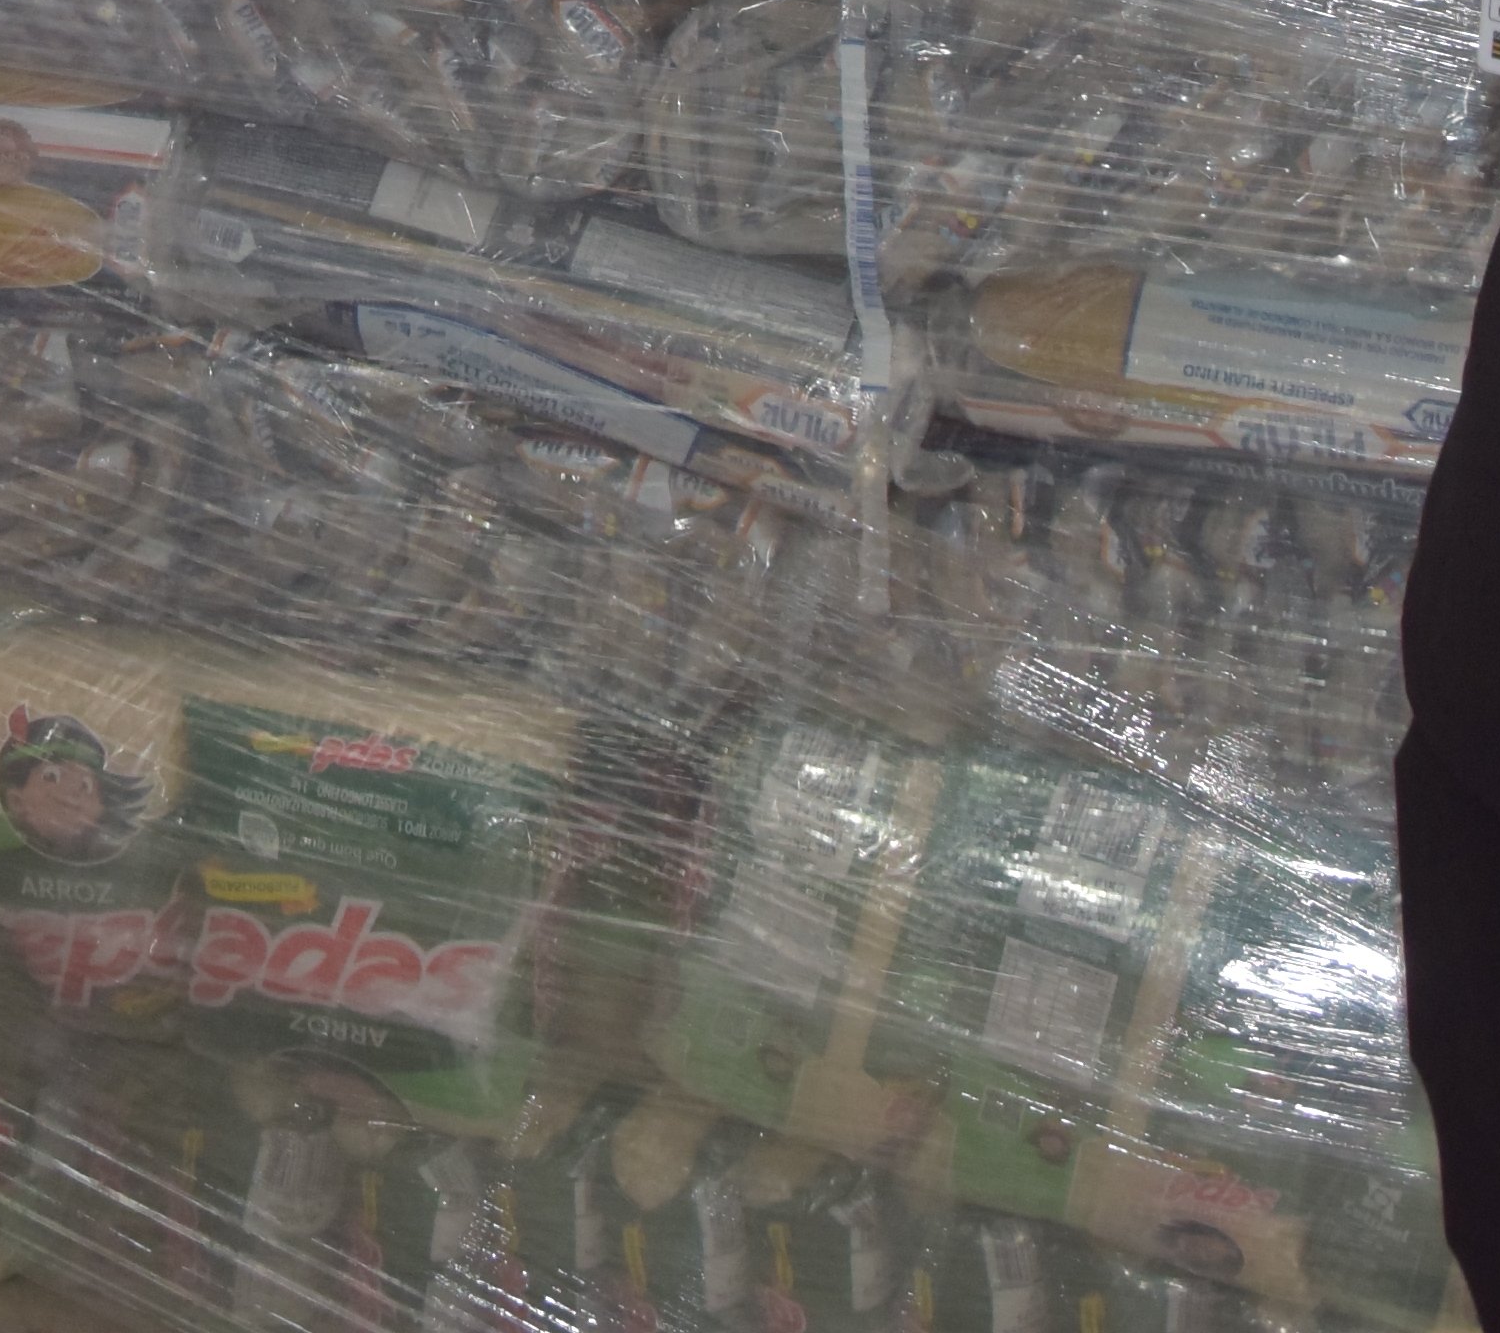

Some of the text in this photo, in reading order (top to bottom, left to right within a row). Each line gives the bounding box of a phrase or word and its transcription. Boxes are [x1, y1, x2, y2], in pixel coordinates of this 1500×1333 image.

[1222, 368, 1265, 391] PILAR
[404, 819, 428, 838] TIPO
[330, 838, 363, 865] bom
[366, 846, 398, 870] Que
[20, 875, 117, 905] ARROZ
[188, 894, 506, 1023] sepé
[288, 1009, 390, 1049] ARROZ
